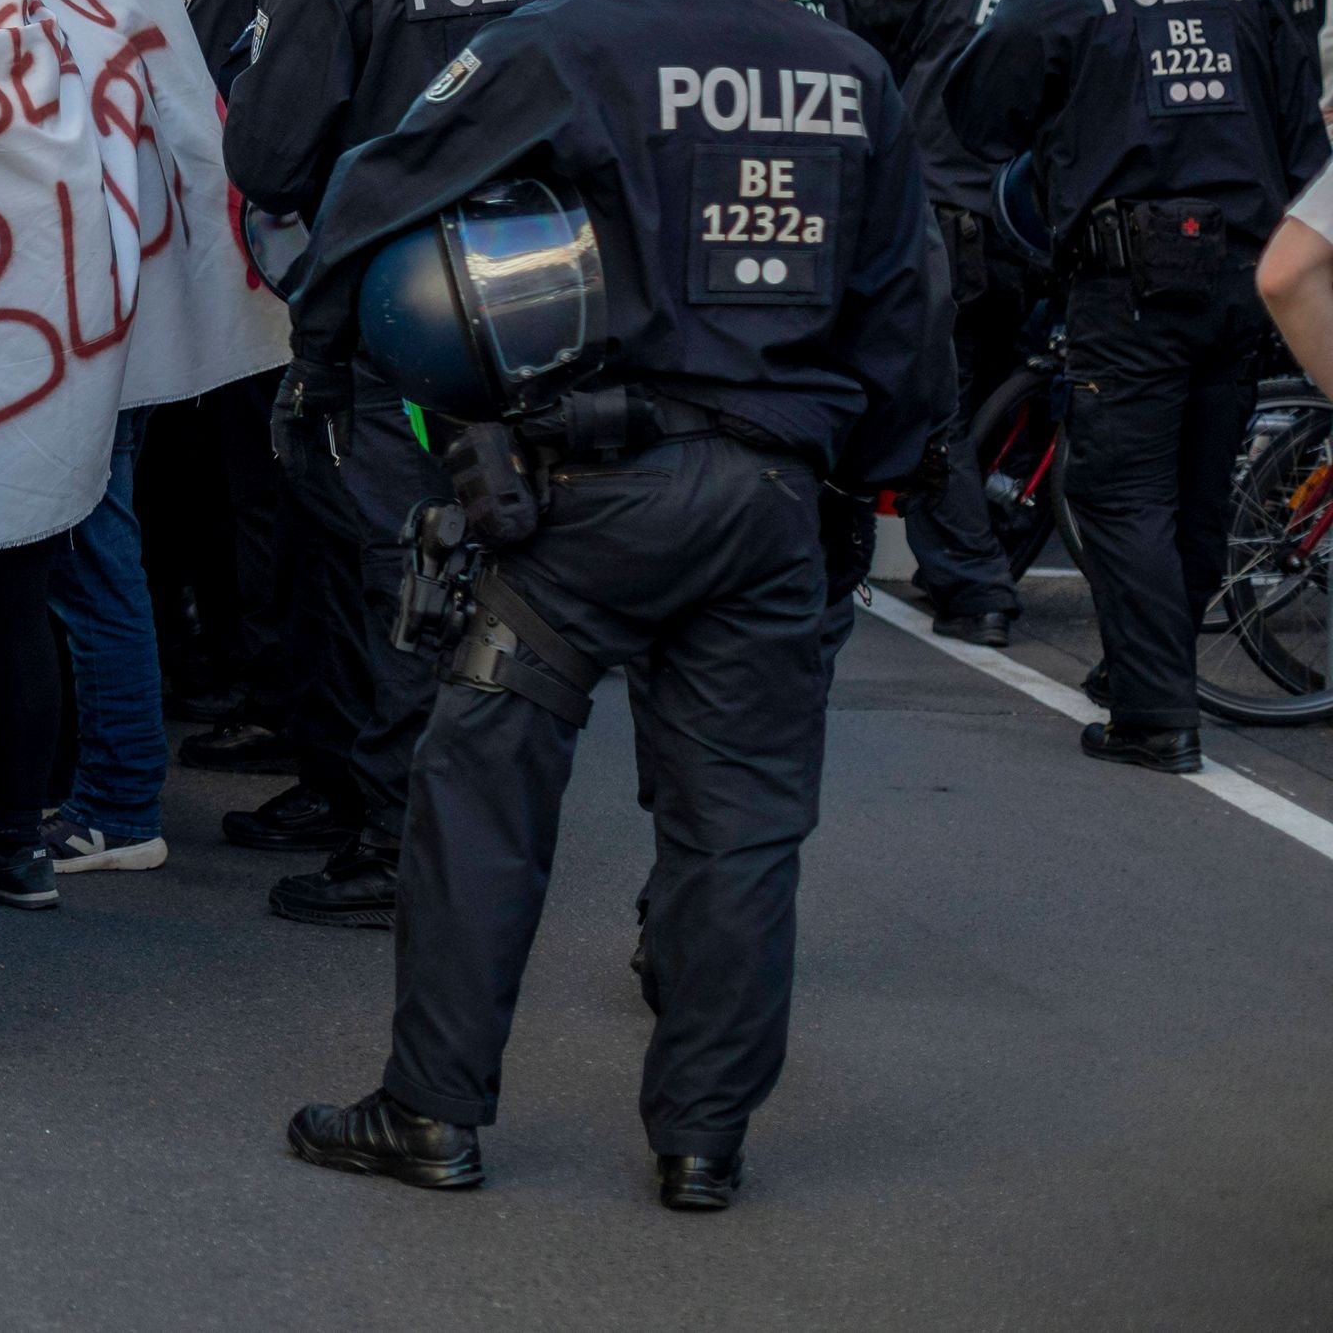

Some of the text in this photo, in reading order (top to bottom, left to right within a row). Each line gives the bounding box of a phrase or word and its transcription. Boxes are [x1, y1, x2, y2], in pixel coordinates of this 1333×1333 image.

[1168, 19, 1206, 45] BE
[1151, 48, 1232, 75] 1222a
[739, 159, 795, 199] BE
[702, 203, 825, 244] 1232a
